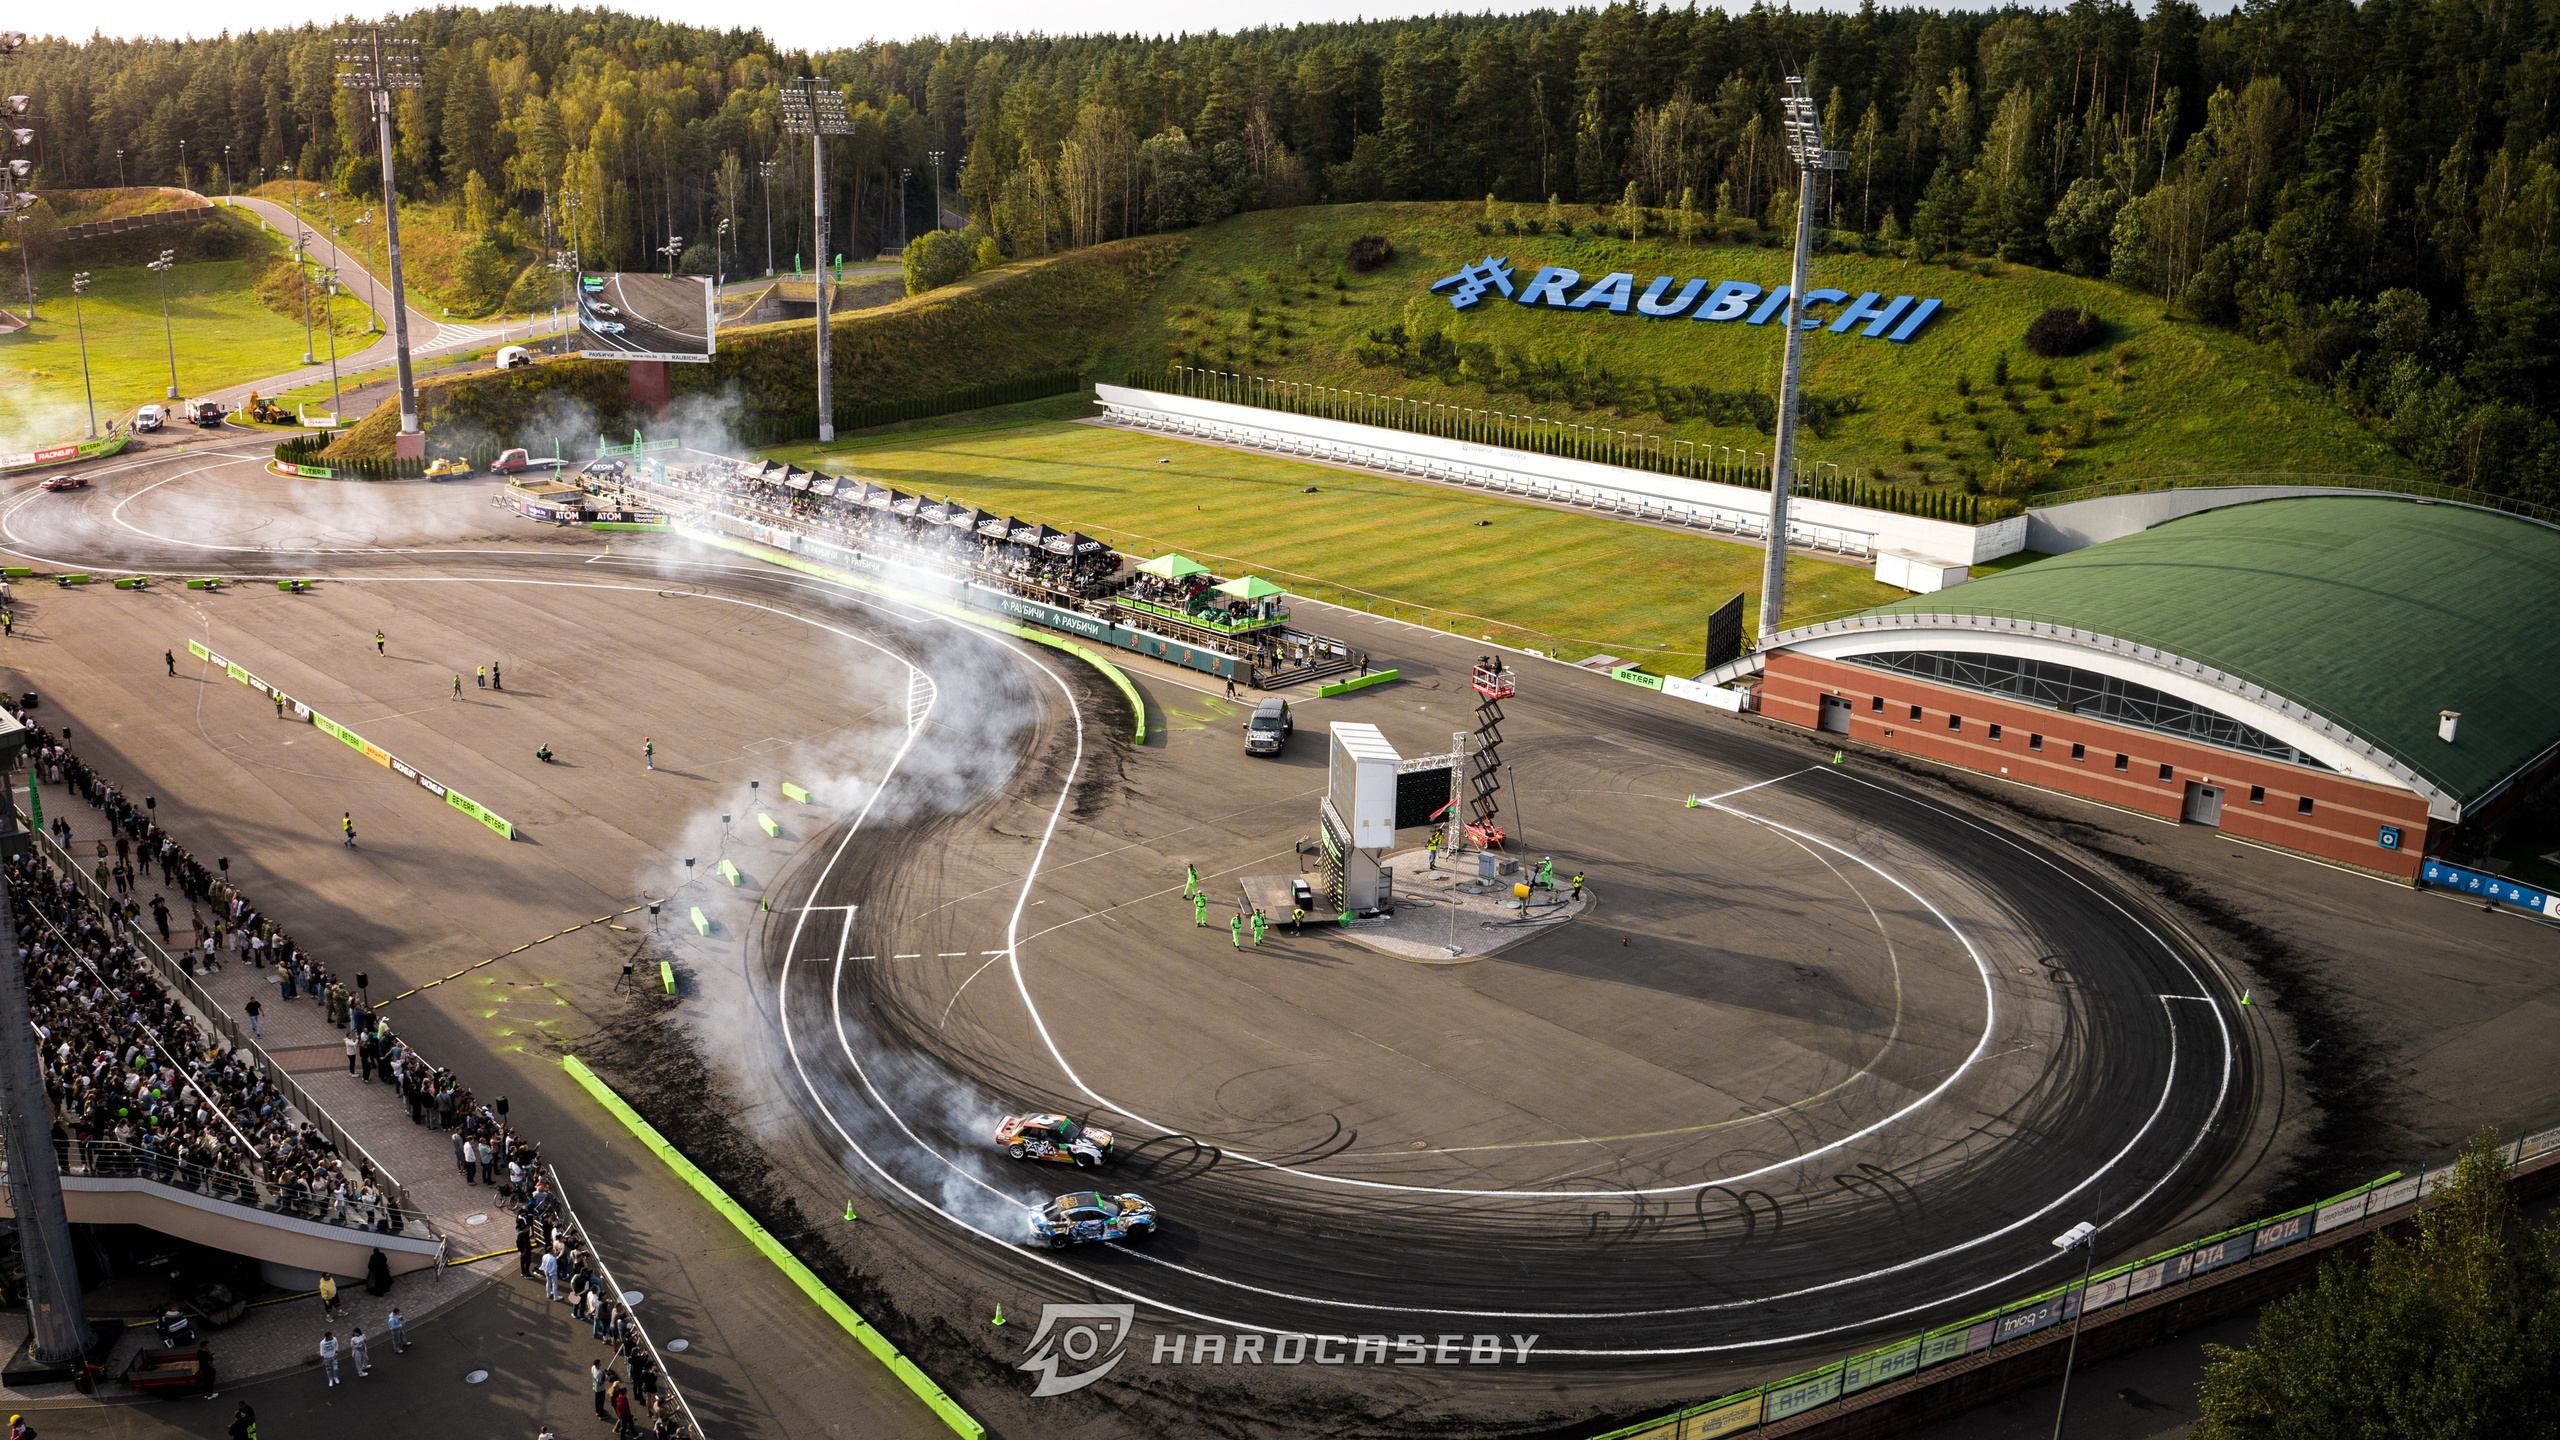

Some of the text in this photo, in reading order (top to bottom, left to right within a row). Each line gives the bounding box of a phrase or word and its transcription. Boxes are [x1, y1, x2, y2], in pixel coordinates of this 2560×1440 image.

[1518, 265, 1943, 345] RAUBICHI
[80, 442, 101, 452] BETERA
[644, 441, 674, 451] BETERA
[302, 467, 327, 476] BETERA
[591, 463, 615, 471] ATOM
[556, 511, 579, 520] ATOM
[597, 512, 621, 521] ATOM
[1017, 532, 1040, 543] ATOM
[1050, 540, 1073, 551] ATOM
[1077, 541, 1101, 552] ATOM
[810, 547, 880, 572] РАУБИЧИ РАУБИЧИ
[1010, 601, 1099, 636] РАУБИЧИ РАУБИЧИ
[191, 643, 206, 656] BETERA
[231, 665, 245, 679] BETERA
[1620, 671, 1655, 686] BETERA
[294, 703, 310, 720] ATOM
[317, 716, 360, 747] BETERA BETERA
[452, 795, 505, 832] BETERA BETERA
